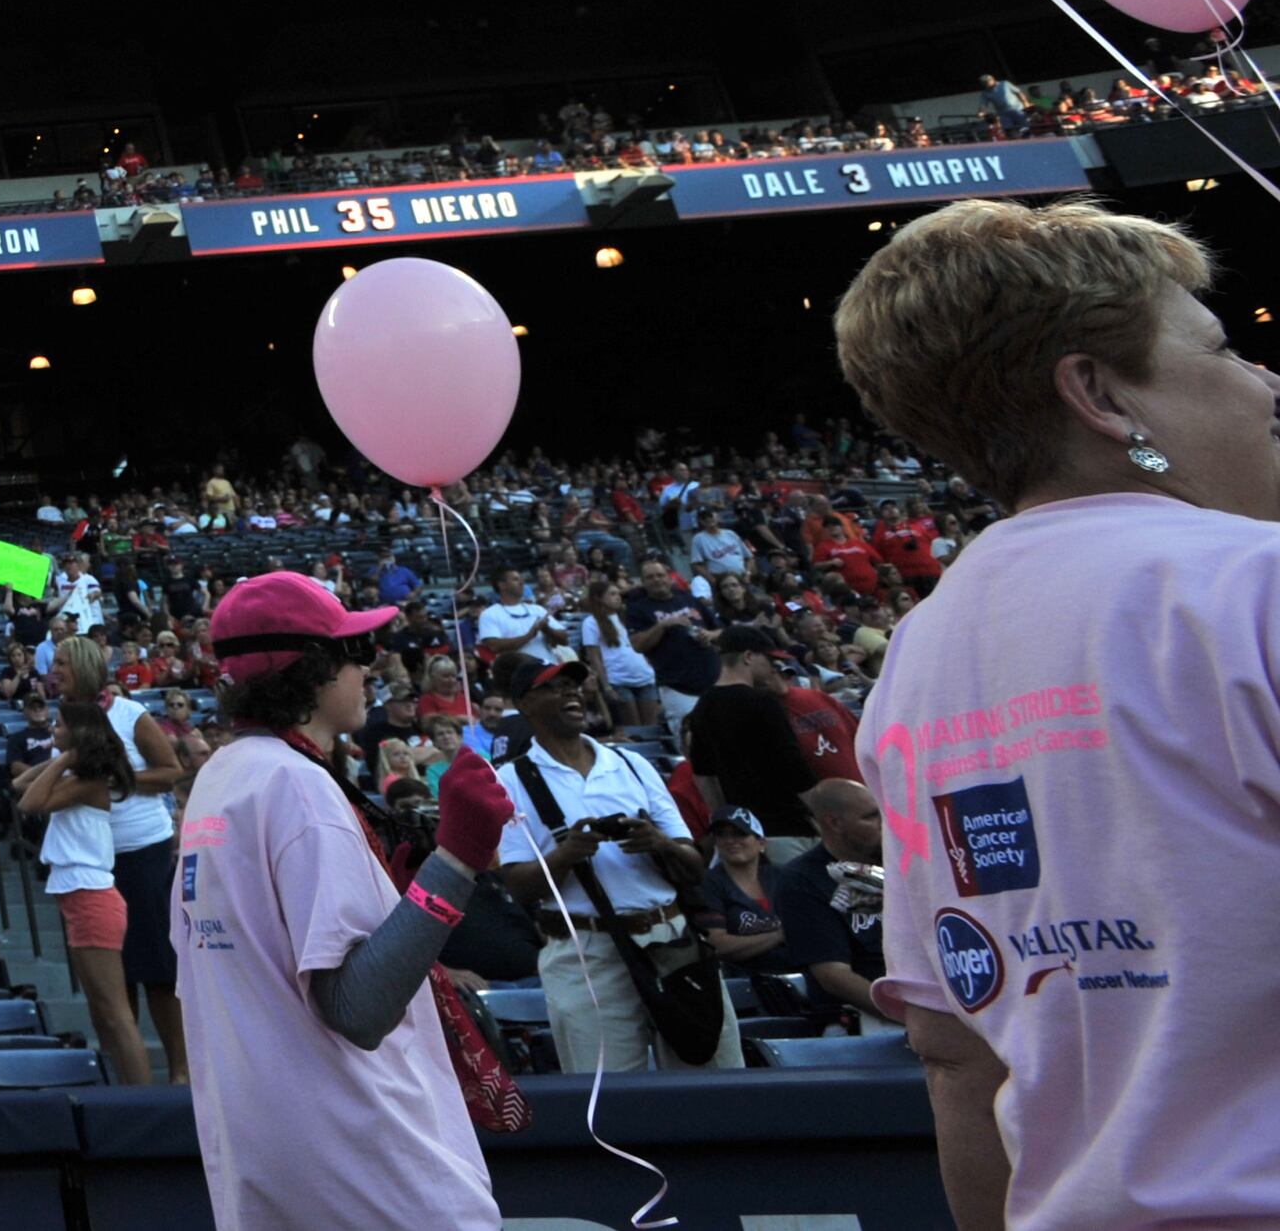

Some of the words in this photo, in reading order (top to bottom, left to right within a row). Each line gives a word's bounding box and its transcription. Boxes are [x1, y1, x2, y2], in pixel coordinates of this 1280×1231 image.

[742, 169, 825, 198] DALE
[841, 163, 871, 193] 3
[886, 155, 1006, 188] MURPHY
[251, 208, 319, 236] PHIL
[336, 197, 396, 233] 35
[410, 191, 519, 224] NIEKRO
[1007, 683, 1102, 728] STRIDES
[962, 808, 1029, 832] American
[967, 831, 1018, 850] Cancer
[972, 847, 1025, 869] Society
[1077, 973, 1124, 991] ancer
